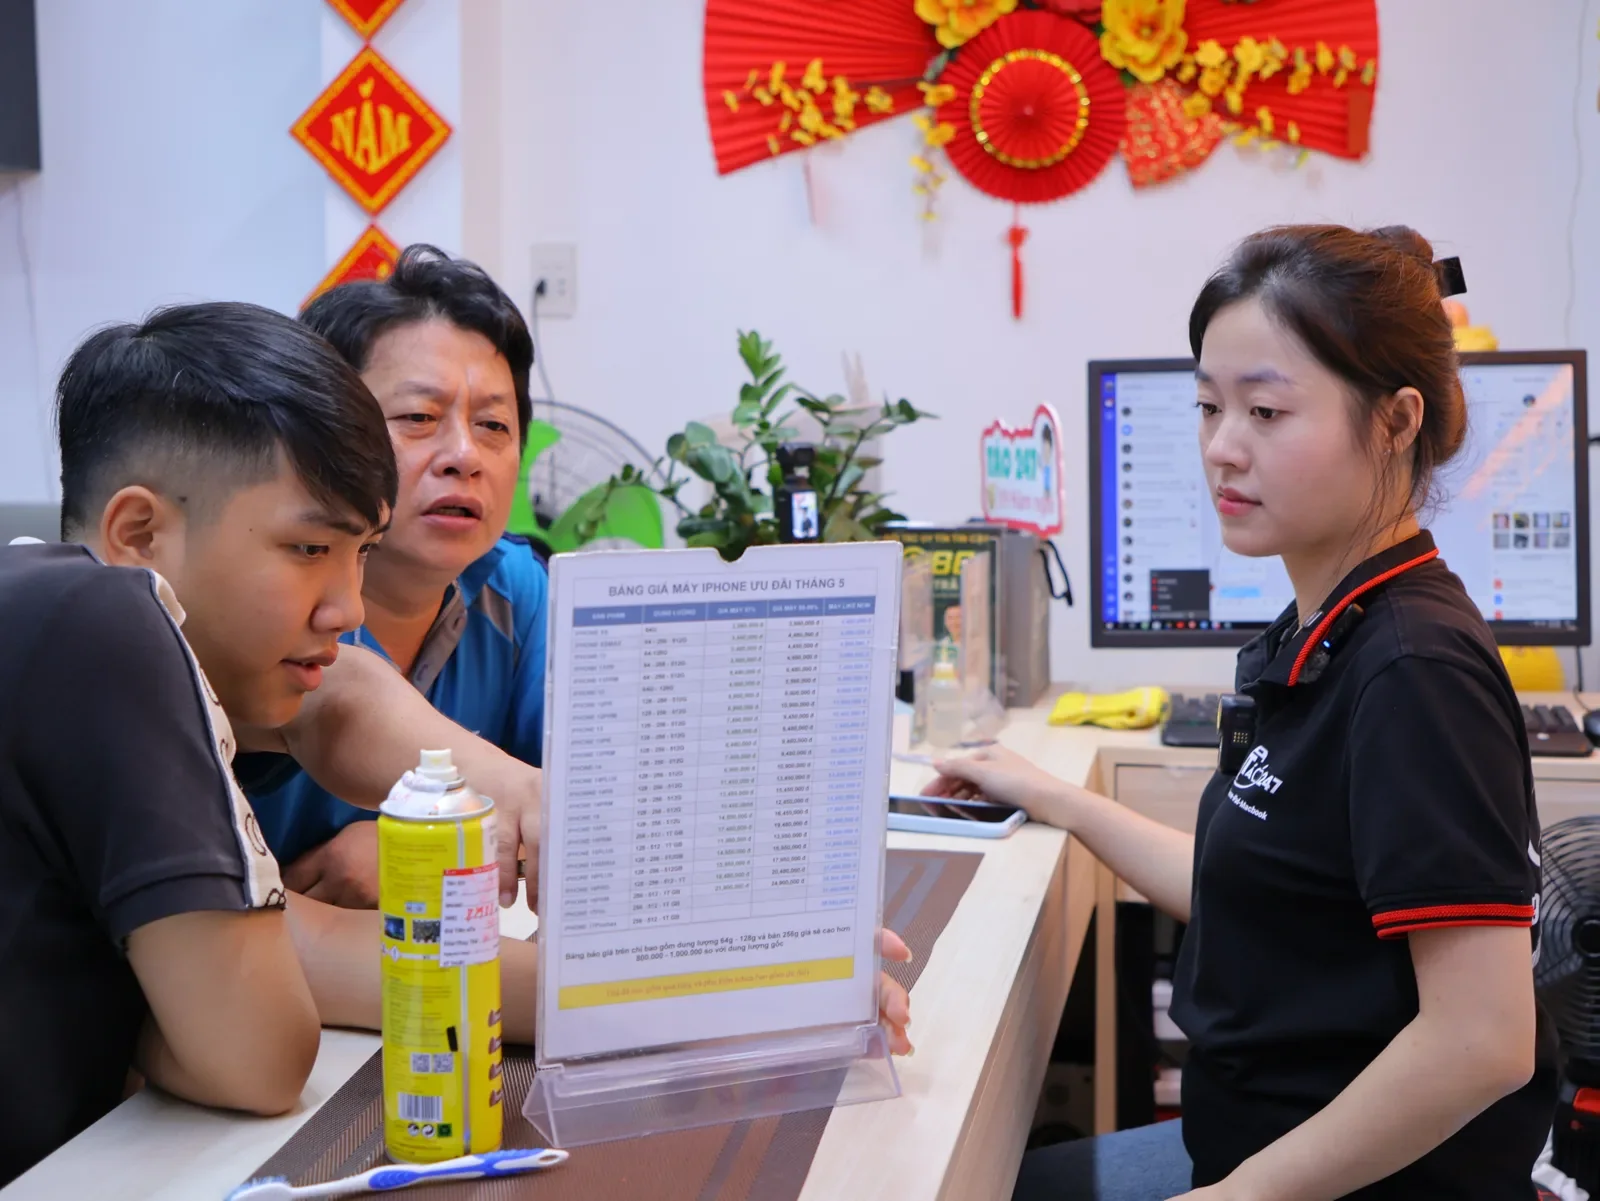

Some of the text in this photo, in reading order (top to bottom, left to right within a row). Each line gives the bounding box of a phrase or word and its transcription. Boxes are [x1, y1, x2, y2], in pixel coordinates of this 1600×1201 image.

[608, 575, 844, 596] BẢNG GIÁ MÁY IPHONE ƯU ĐÃI THÁNG 5
[635, 952, 663, 961] 800.000
[669, 948, 702, 958] 1.000.000
[728, 944, 745, 954] dung
[747, 942, 769, 952] lượng
[770, 938, 783, 949] gốc
[659, 940, 674, 952] gồm
[676, 940, 694, 950] dung
[696, 938, 718, 948] lượng
[720, 936, 733, 945] 64g
[739, 934, 756, 943] 128g
[782, 930, 798, 939] 256g
